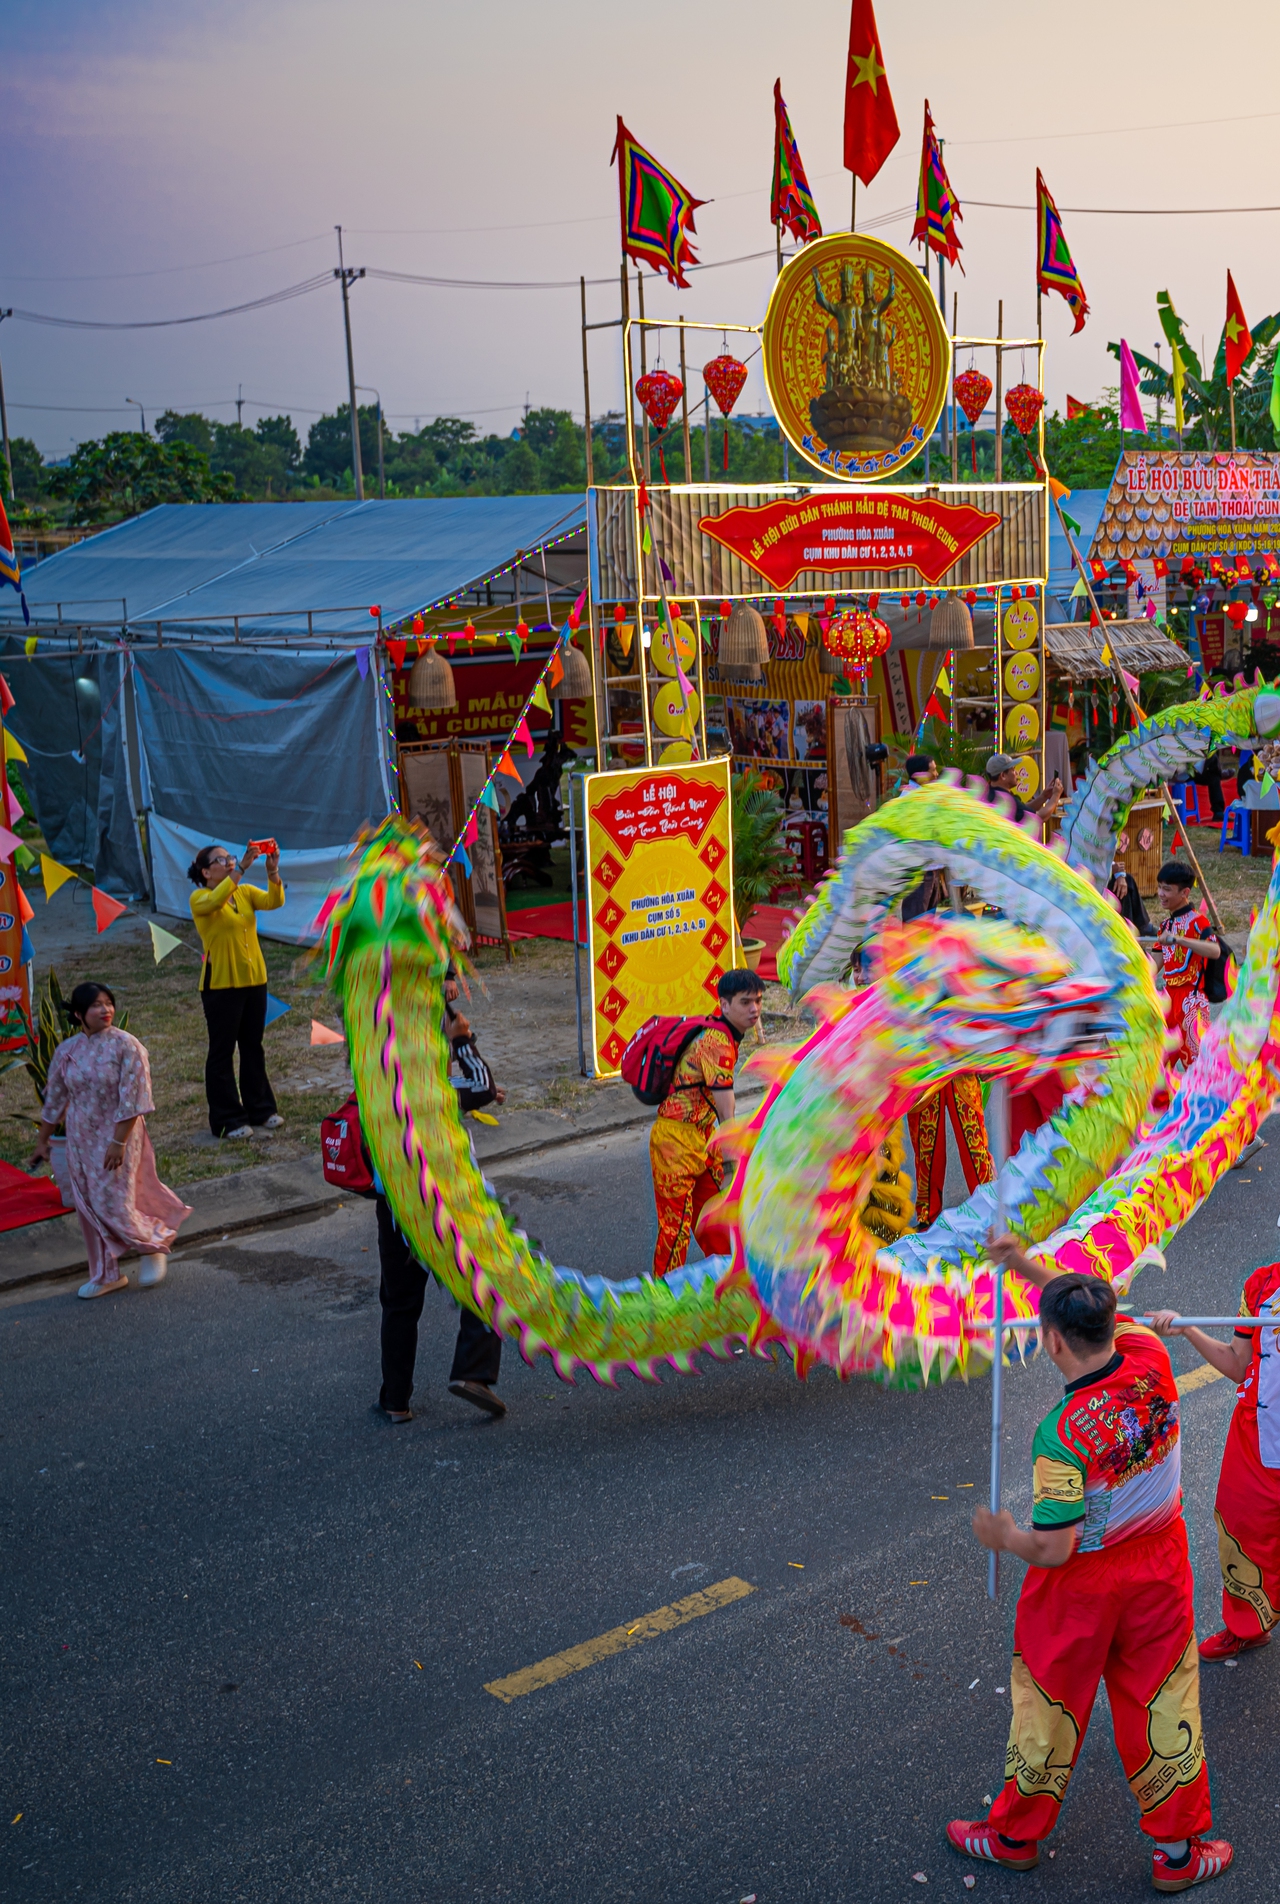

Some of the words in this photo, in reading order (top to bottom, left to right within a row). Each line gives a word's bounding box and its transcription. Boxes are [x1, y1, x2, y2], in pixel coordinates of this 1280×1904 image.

[1128, 457, 1147, 490] LỄ
[1151, 463, 1178, 496] HỘI
[1182, 461, 1213, 490] BỬU
[1218, 461, 1249, 490] ĐẢN
[1173, 500, 1191, 522] ĐỆ
[1193, 502, 1218, 517] TAM
[1221, 495, 1254, 516] THOẢI
[762, 526, 781, 548] HỘI
[821, 500, 853, 518] THÁNH
[891, 504, 910, 522] TAM
[936, 526, 959, 554] CUNG
[822, 526, 854, 541] PHƯỜNG
[856, 526, 872, 541] HÒA
[873, 525, 895, 540] XUÂN
[803, 547, 822, 562] CỤM
[823, 547, 840, 560] KHU
[841, 544, 858, 559] DÂN
[859, 545, 871, 559] CƯ
[880, 546, 888, 559] 2,
[889, 545, 897, 559] 3,
[898, 545, 906, 558] 4,
[907, 545, 913, 557] 5
[469, 691, 523, 713] MẪU
[447, 714, 515, 733] CUNG
[658, 783, 677, 801] HỘI
[631, 896, 660, 911] PHƯỜNG
[661, 892, 675, 905] HÒA
[676, 888, 695, 902] XUÂN
[647, 911, 664, 924] CỤM
[665, 906, 674, 920] SỐ
[675, 908, 681, 918] 5
[622, 932, 639, 945] (KHU
[640, 928, 655, 941] DÂN
[656, 925, 666, 937] CƯ
